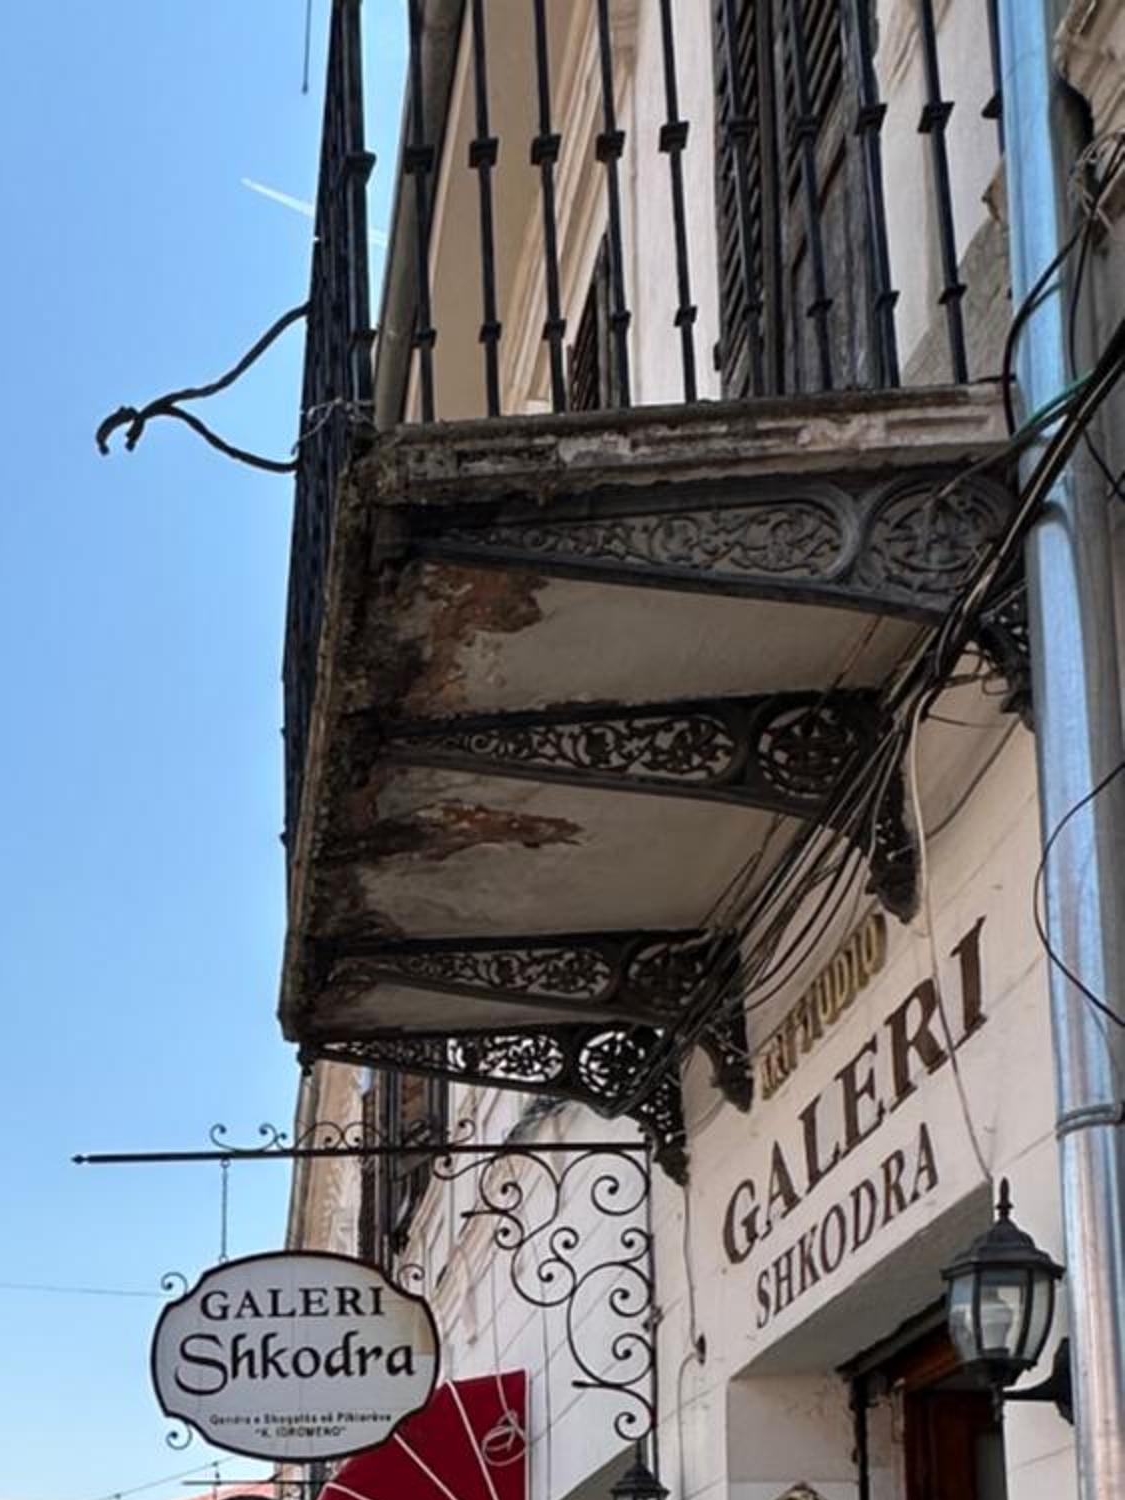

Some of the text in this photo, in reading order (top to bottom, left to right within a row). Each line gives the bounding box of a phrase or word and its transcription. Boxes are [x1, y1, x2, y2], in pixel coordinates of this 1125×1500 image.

[722, 915, 988, 1264] GALERI
[756, 1122, 939, 1329] SHKODRA
[175, 1331, 415, 1396] Shkodra
[200, 1286, 386, 1321] GALERI
